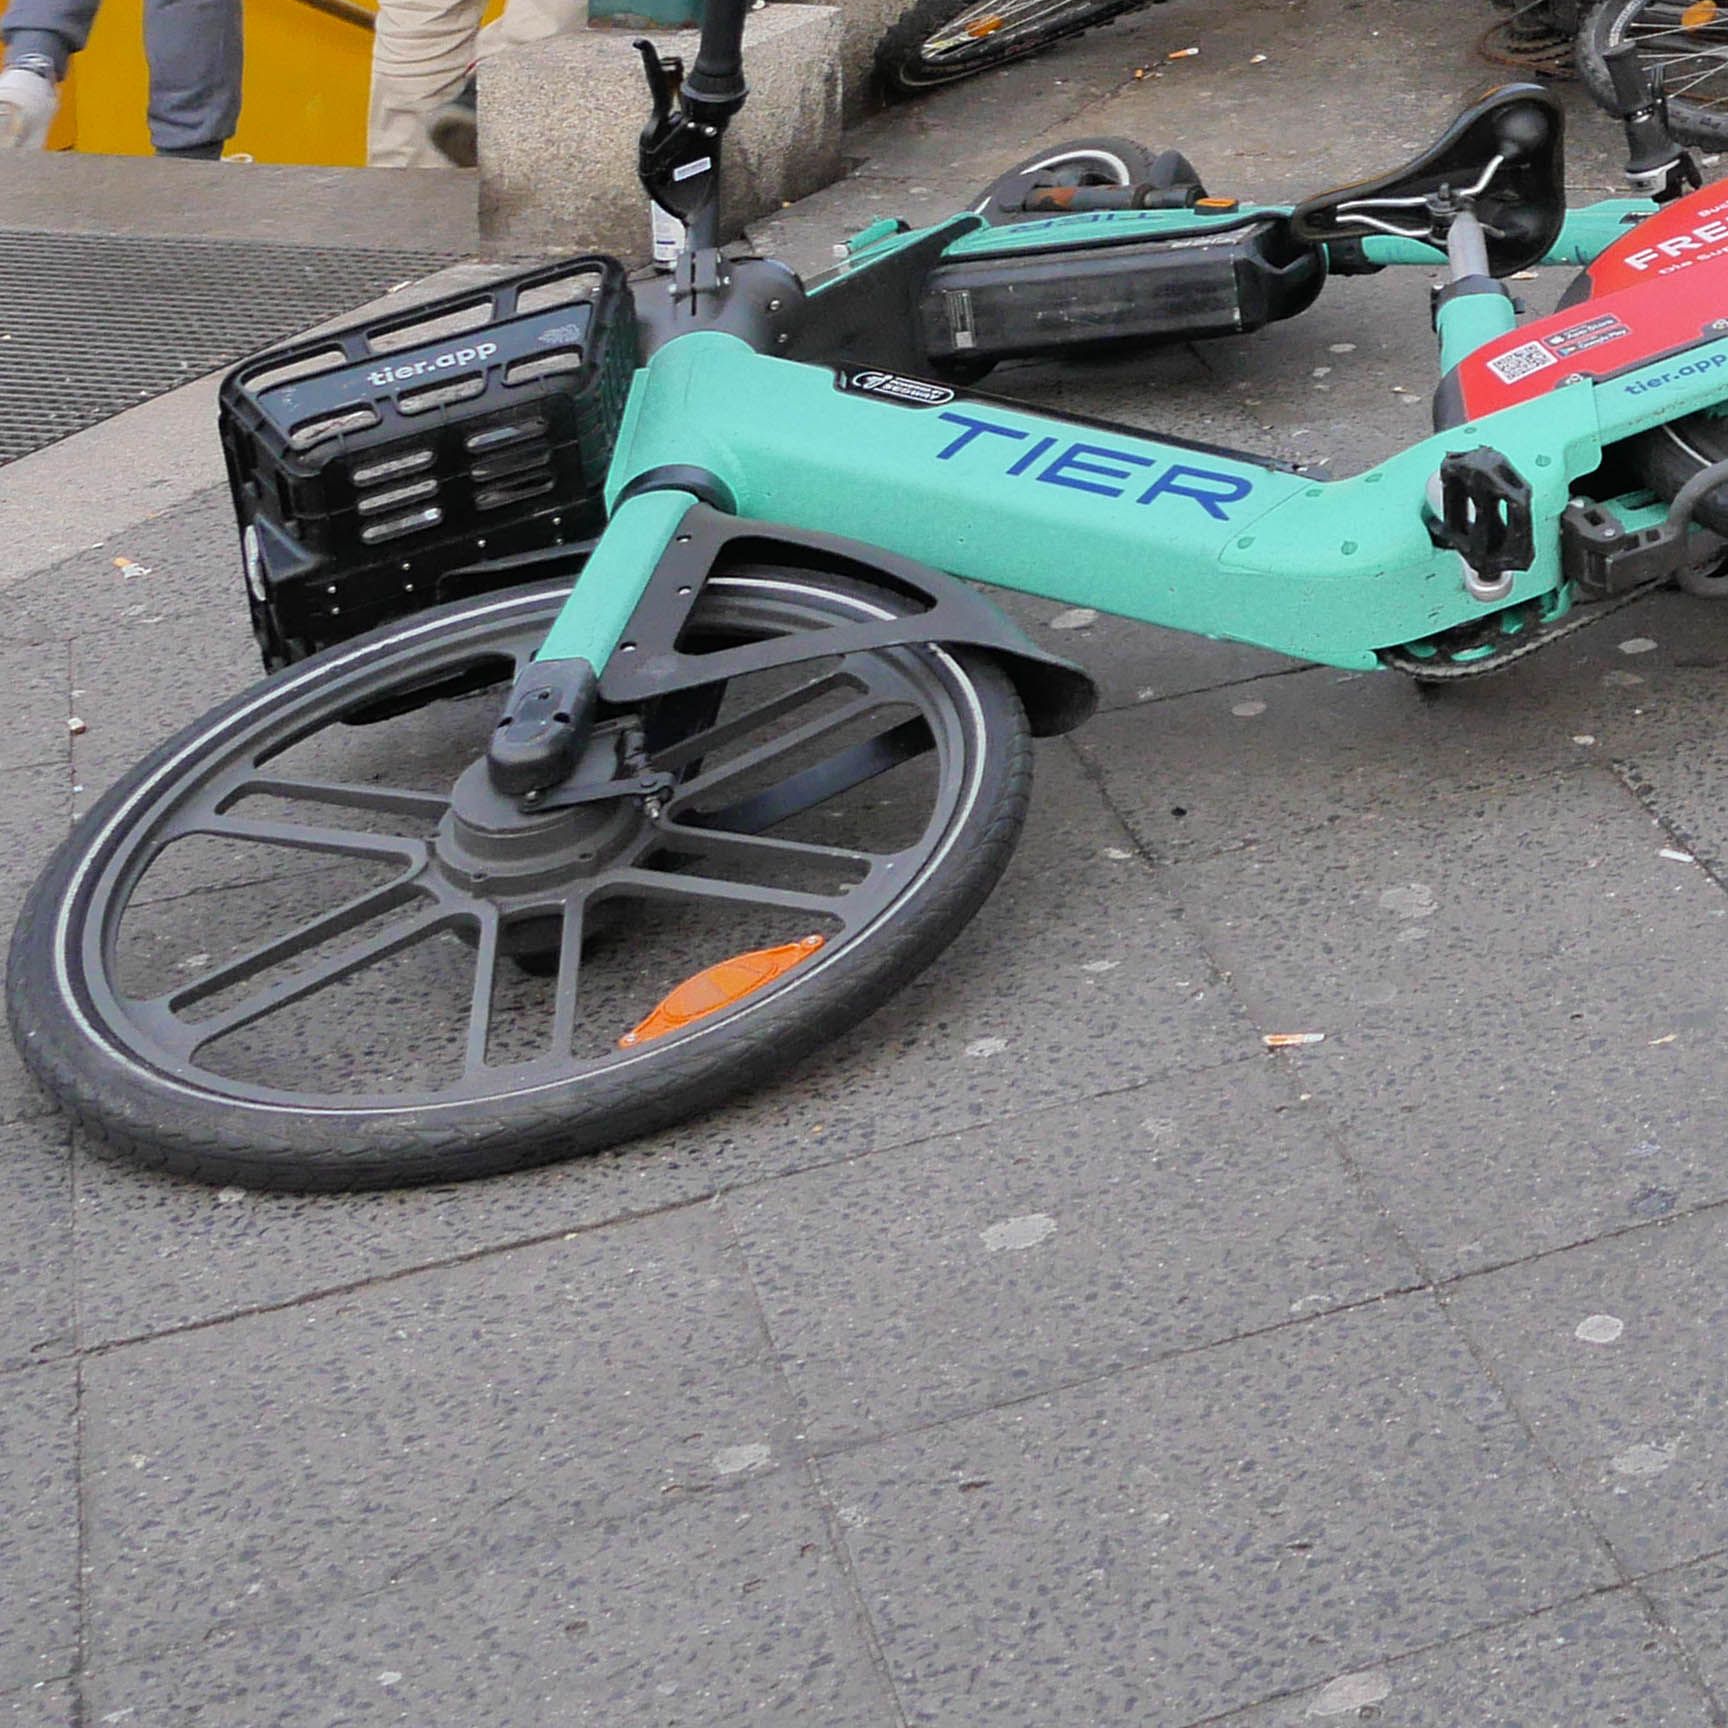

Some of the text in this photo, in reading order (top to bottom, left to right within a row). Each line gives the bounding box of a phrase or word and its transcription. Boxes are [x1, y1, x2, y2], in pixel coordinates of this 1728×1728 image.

[1658, 259, 1693, 276] Die
[366, 340, 498, 388] tier.app
[1624, 352, 1728, 396] tier.app
[935, 412, 1255, 522] TIER
